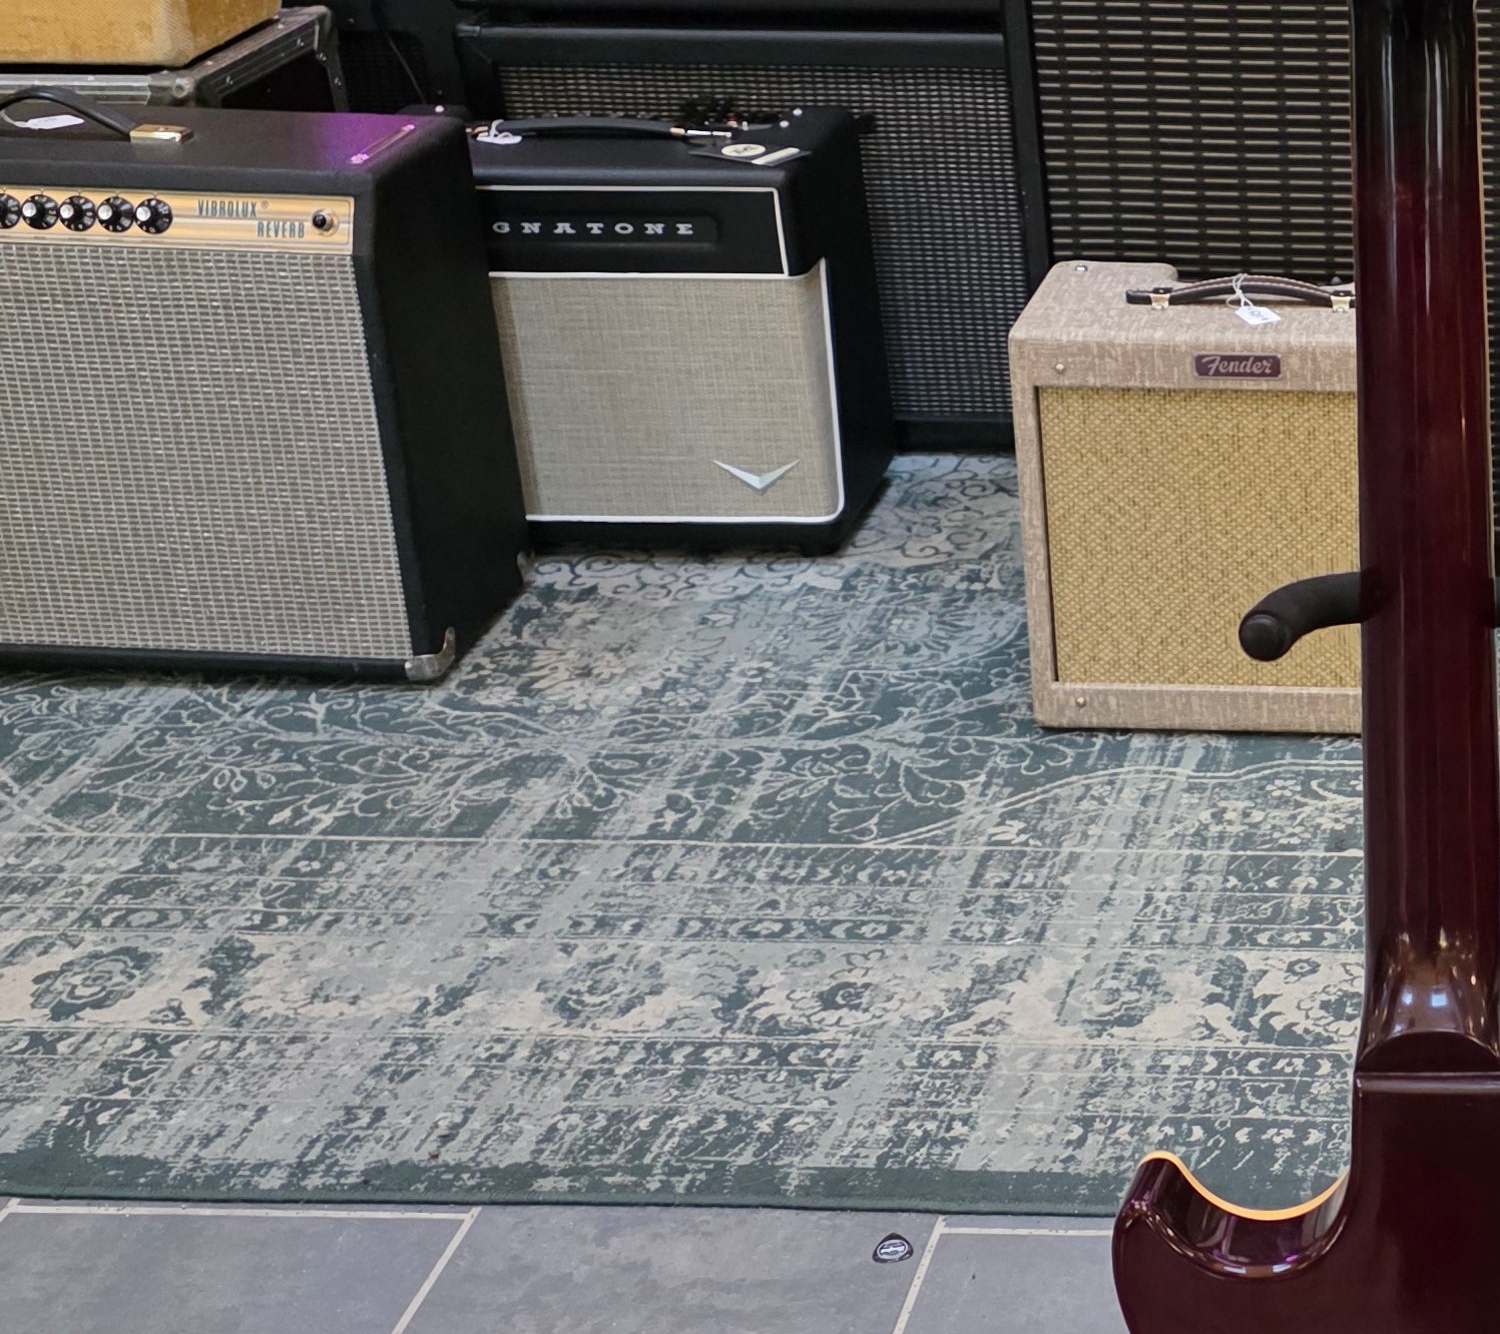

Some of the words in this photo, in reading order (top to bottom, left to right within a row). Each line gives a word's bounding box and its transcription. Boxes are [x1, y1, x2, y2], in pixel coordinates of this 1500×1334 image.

[197, 199, 258, 218] VIBROLUX
[257, 220, 305, 238] REVERB
[492, 221, 694, 235] GNATONE
[1201, 355, 1273, 376] Fender
